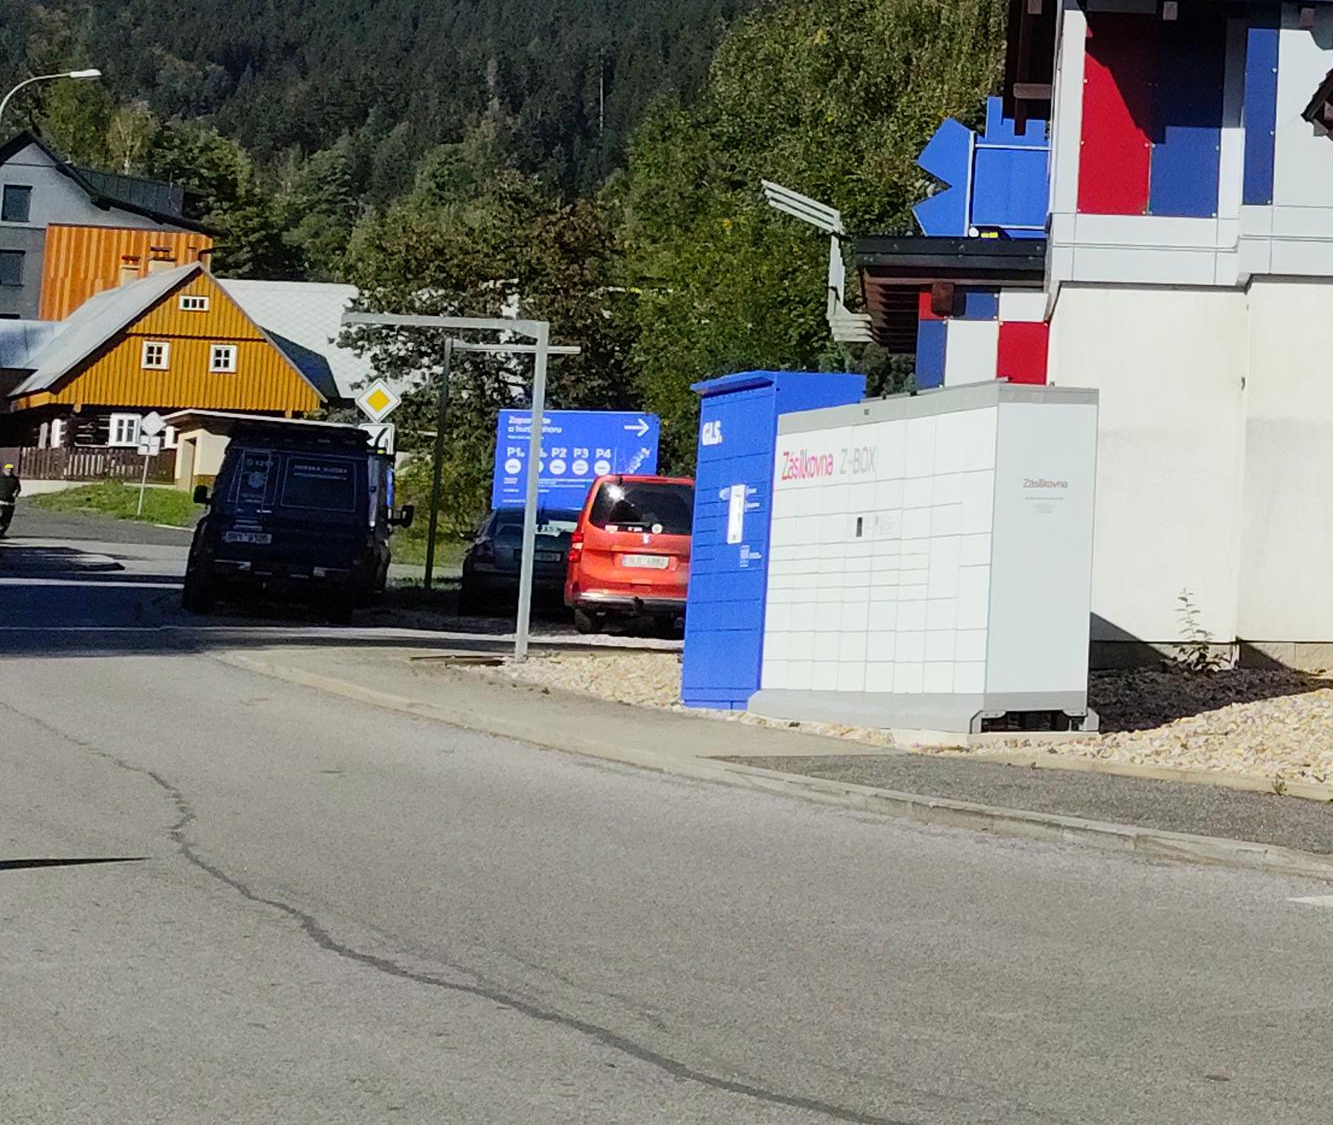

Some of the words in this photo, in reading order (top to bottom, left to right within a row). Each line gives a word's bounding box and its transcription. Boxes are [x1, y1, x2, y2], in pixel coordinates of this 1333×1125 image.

[551, 447, 567, 458] P2
[573, 448, 589, 458] P3
[595, 448, 611, 459] P4
[781, 448, 833, 480] Zásilkovna
[839, 445, 877, 474] Z-BOX
